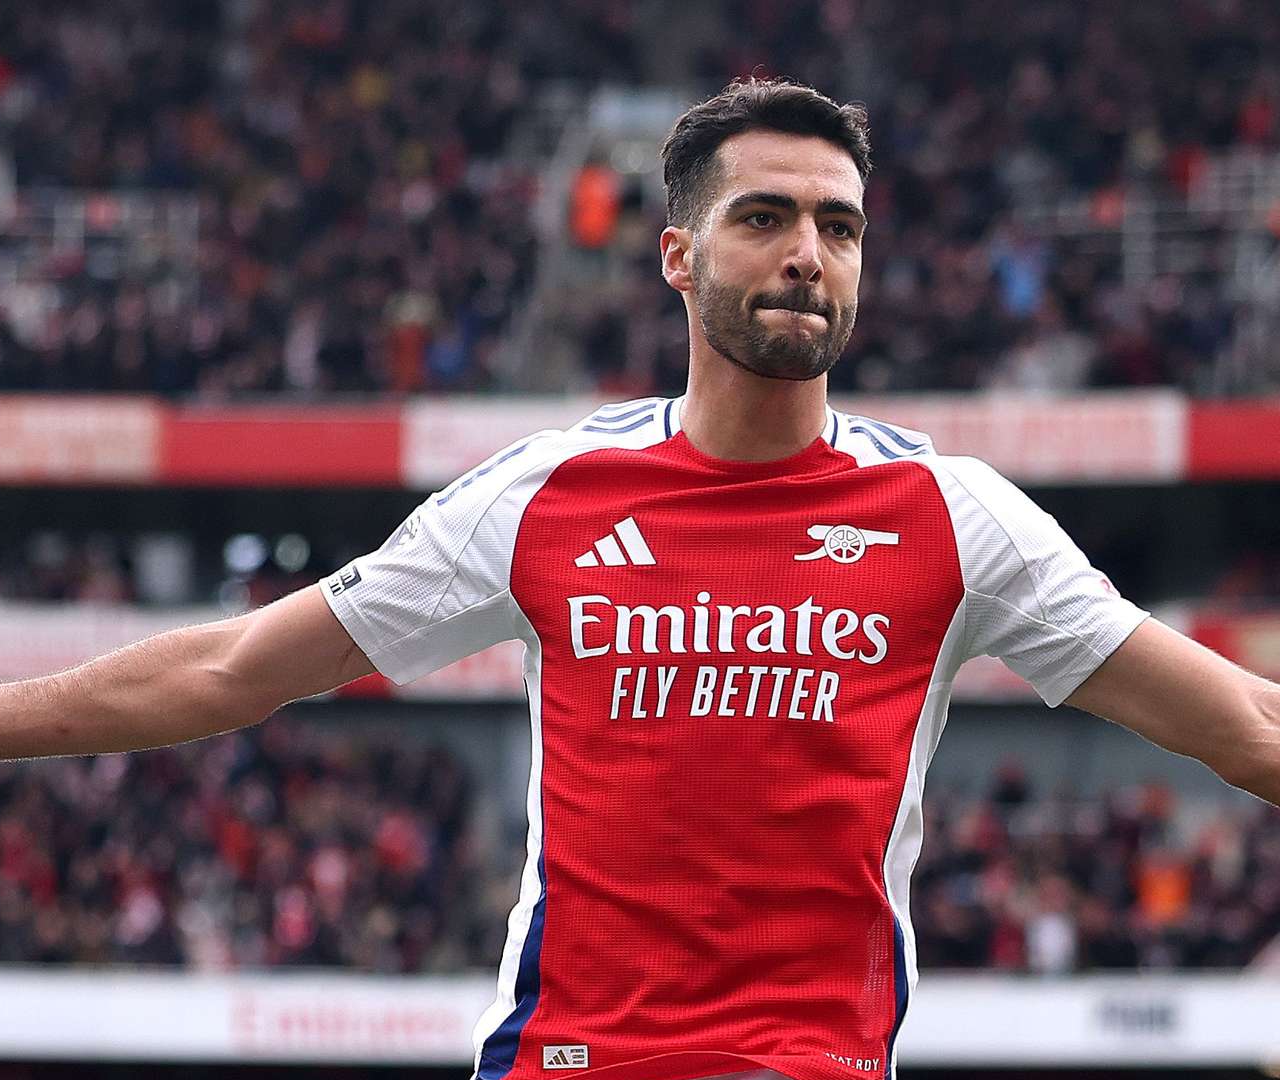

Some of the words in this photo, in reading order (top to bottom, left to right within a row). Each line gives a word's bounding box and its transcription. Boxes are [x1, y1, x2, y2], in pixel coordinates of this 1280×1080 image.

[567, 591, 891, 665] Emirates
[609, 666, 679, 720] FLY
[689, 666, 840, 722] BETTER
[824, 1052, 880, 1072] AT.RDY
